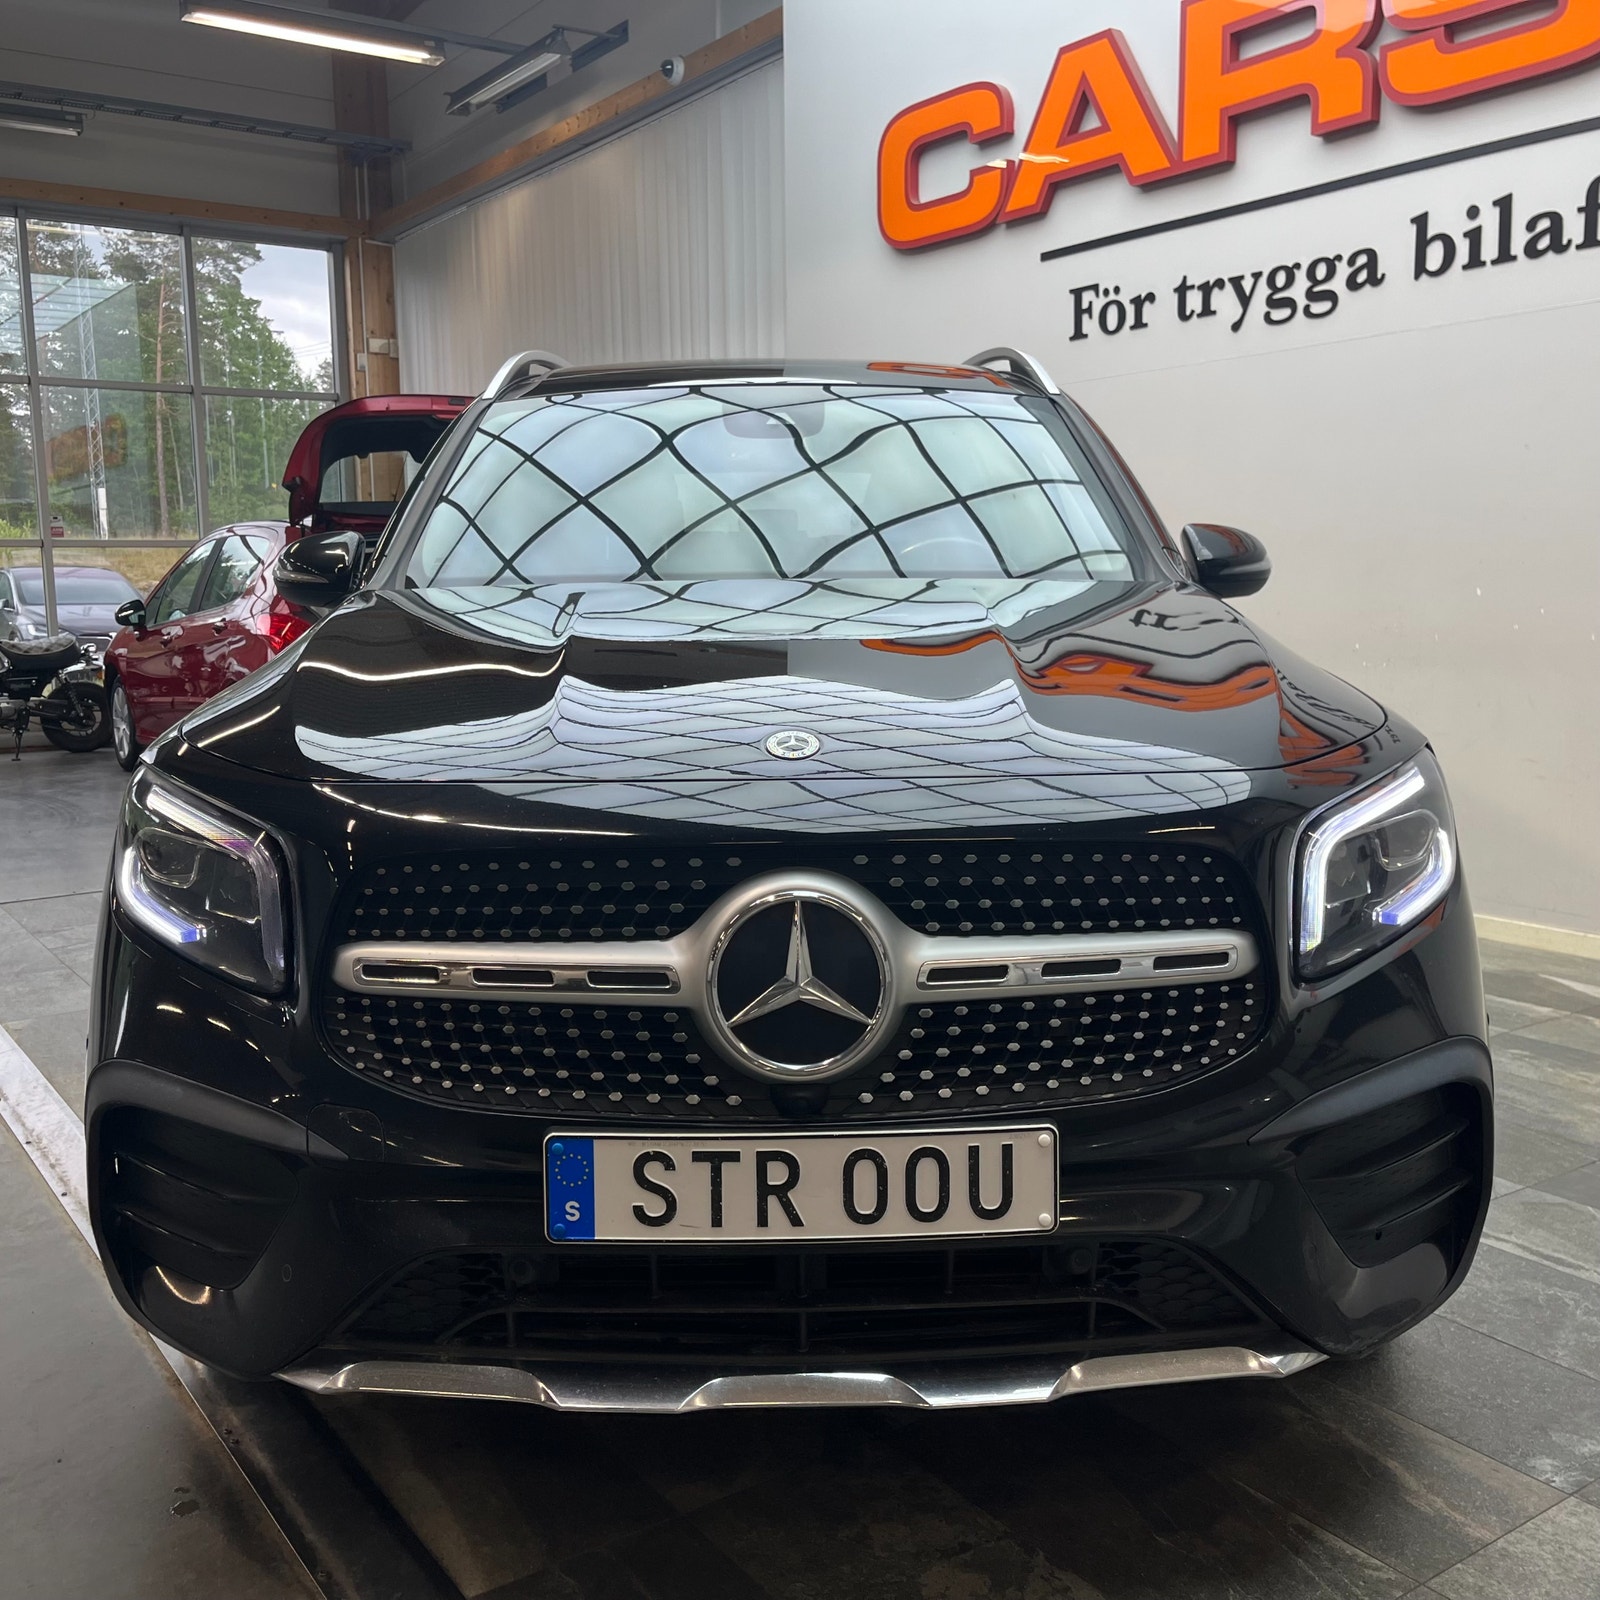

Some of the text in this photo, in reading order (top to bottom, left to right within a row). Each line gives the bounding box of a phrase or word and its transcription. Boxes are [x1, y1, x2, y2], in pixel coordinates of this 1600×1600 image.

[1068, 282, 1156, 342] För
[1173, 247, 1386, 333] trygga
[564, 1200, 581, 1222] S
[631, 1149, 805, 1228] STR
